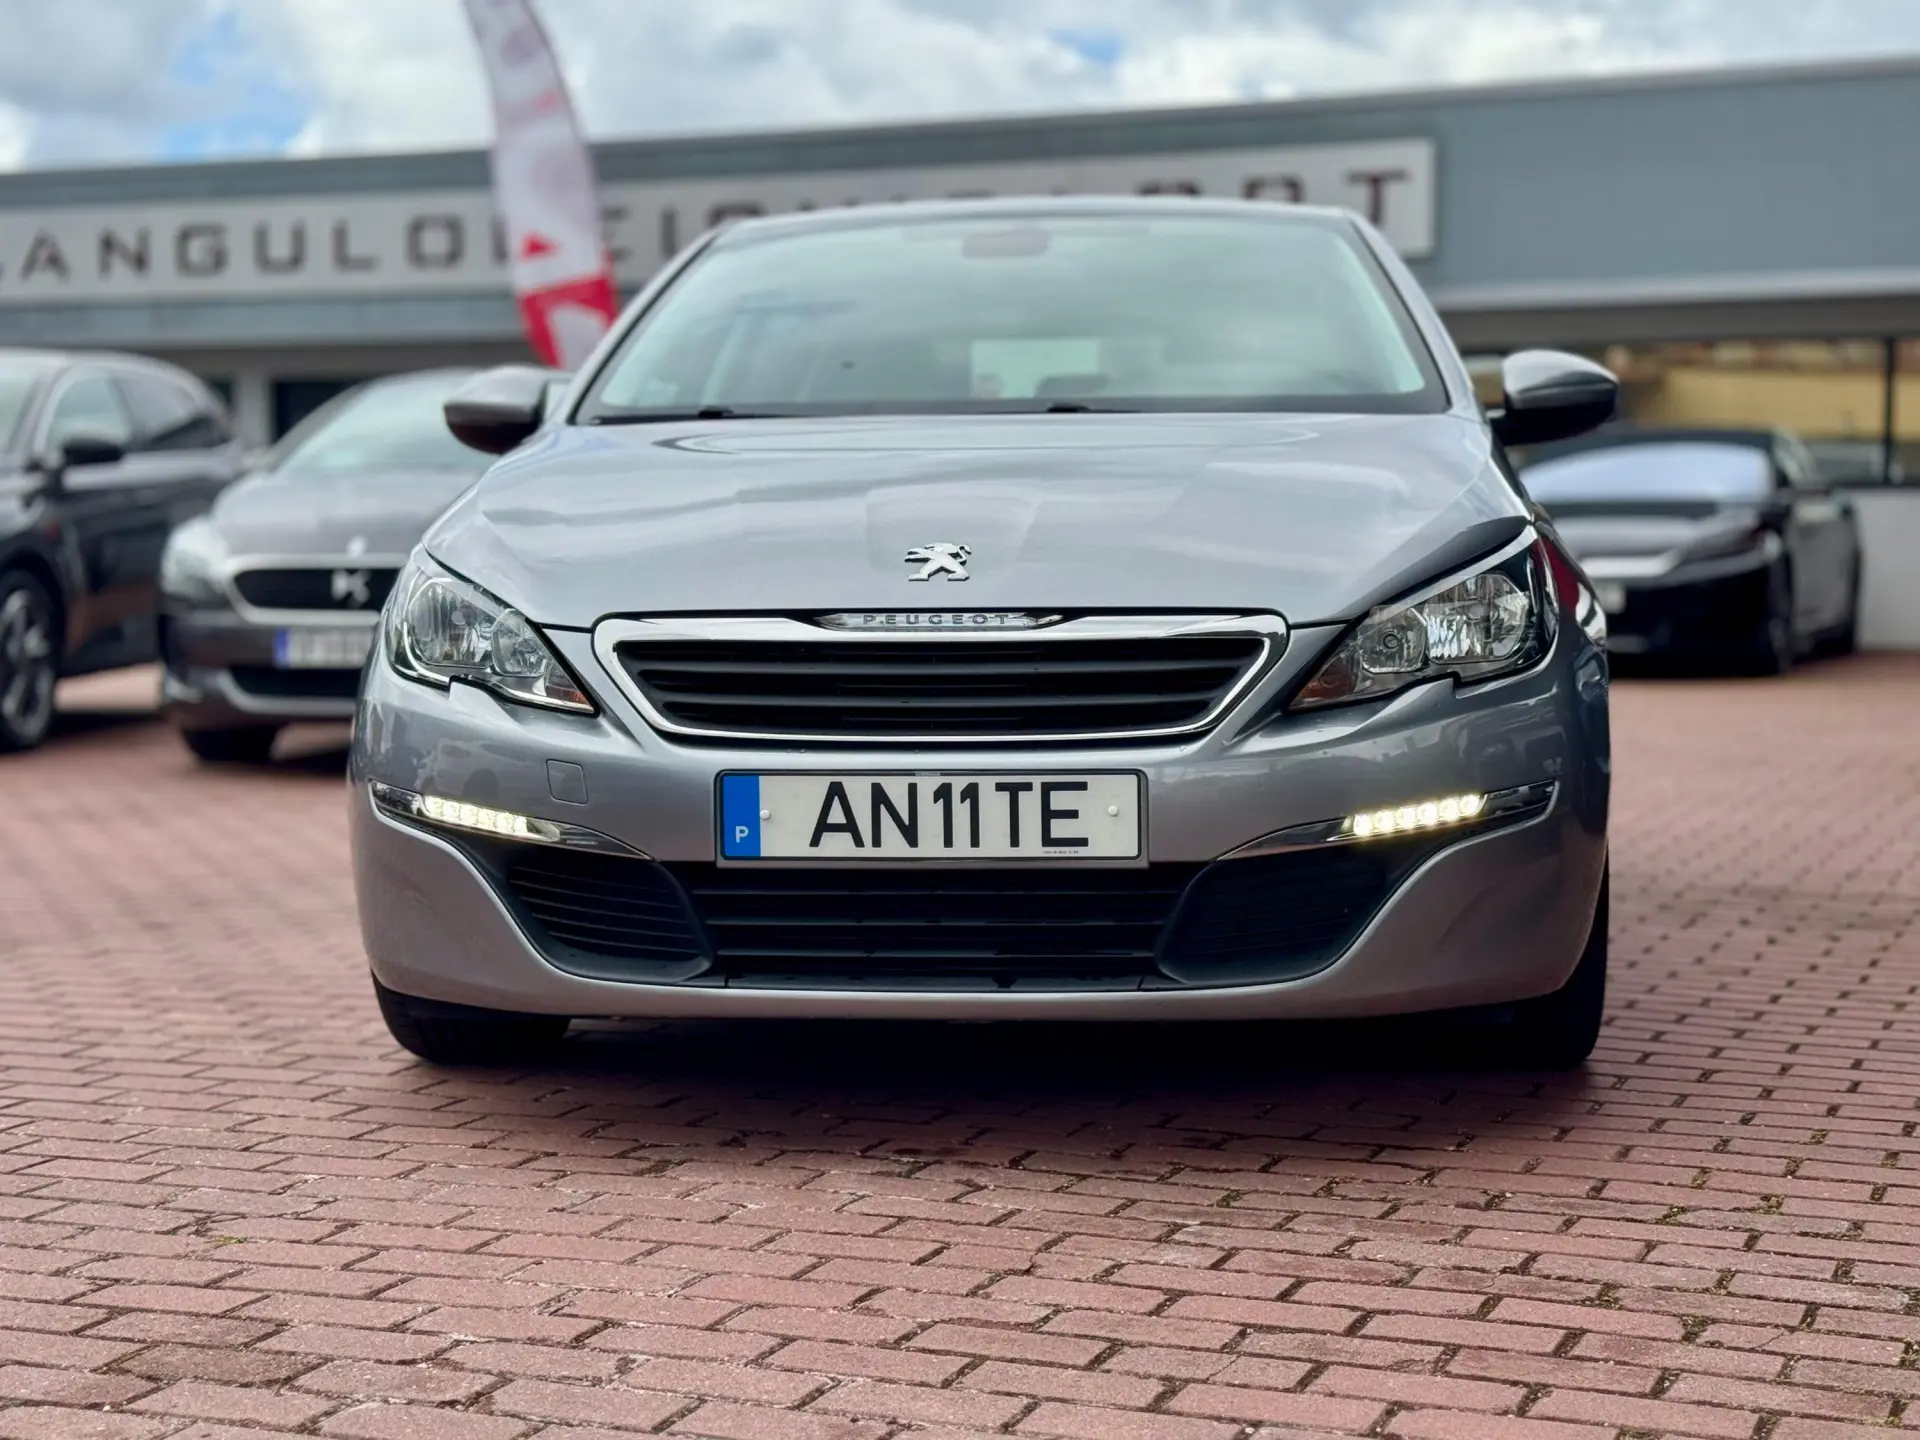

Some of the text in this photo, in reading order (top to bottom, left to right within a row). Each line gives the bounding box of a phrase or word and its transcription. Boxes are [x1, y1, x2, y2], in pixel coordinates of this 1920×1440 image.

[0, 212, 465, 283] ANGULO
[862, 614, 1009, 625] PEUGEOT
[735, 825, 749, 843] P
